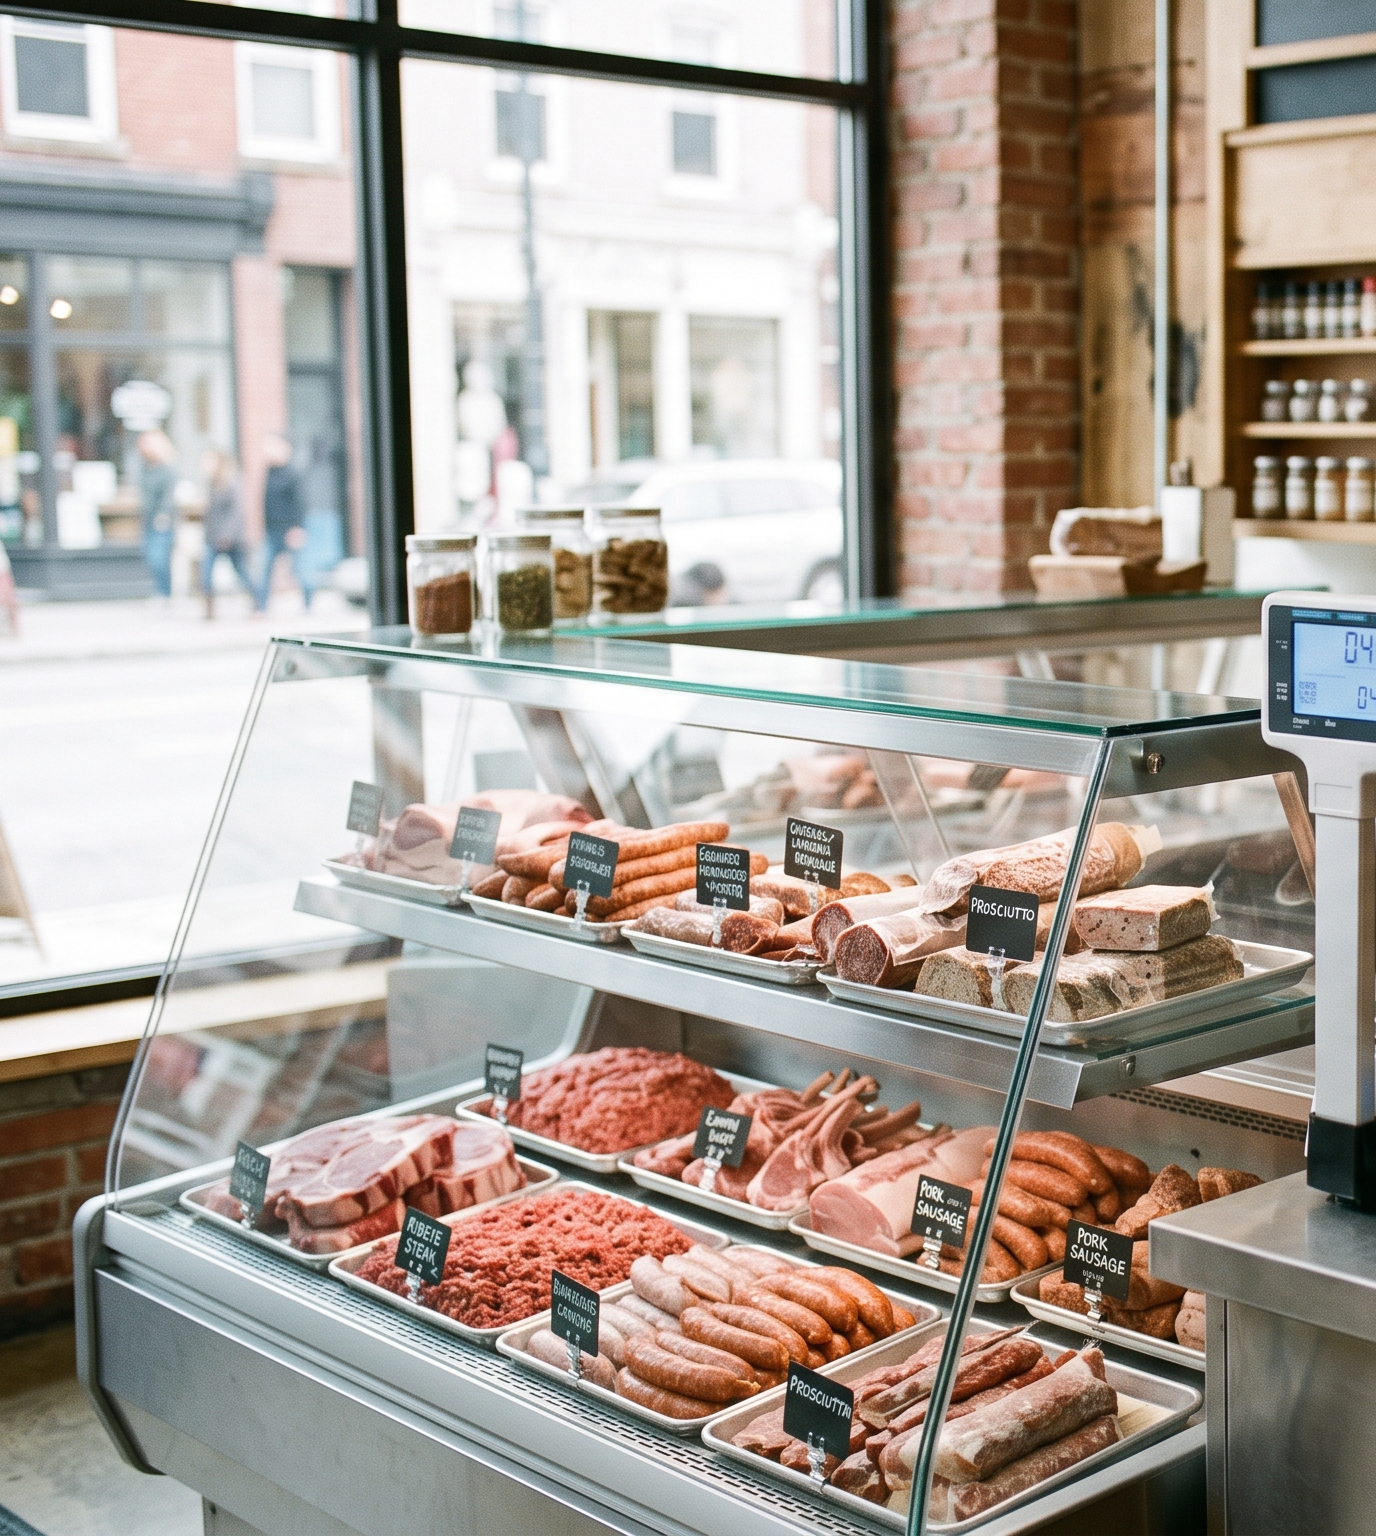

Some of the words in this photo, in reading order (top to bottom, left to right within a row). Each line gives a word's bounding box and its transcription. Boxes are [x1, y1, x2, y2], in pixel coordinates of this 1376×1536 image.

[971, 897, 1035, 921] PROSCIUTTO
[919, 1180, 945, 1203] PORK
[915, 1199, 965, 1231] SAUSAGE
[404, 1237, 437, 1266] STEAK
[1077, 1227, 1109, 1252] PORK
[1069, 1244, 1126, 1276] SAUSAGE
